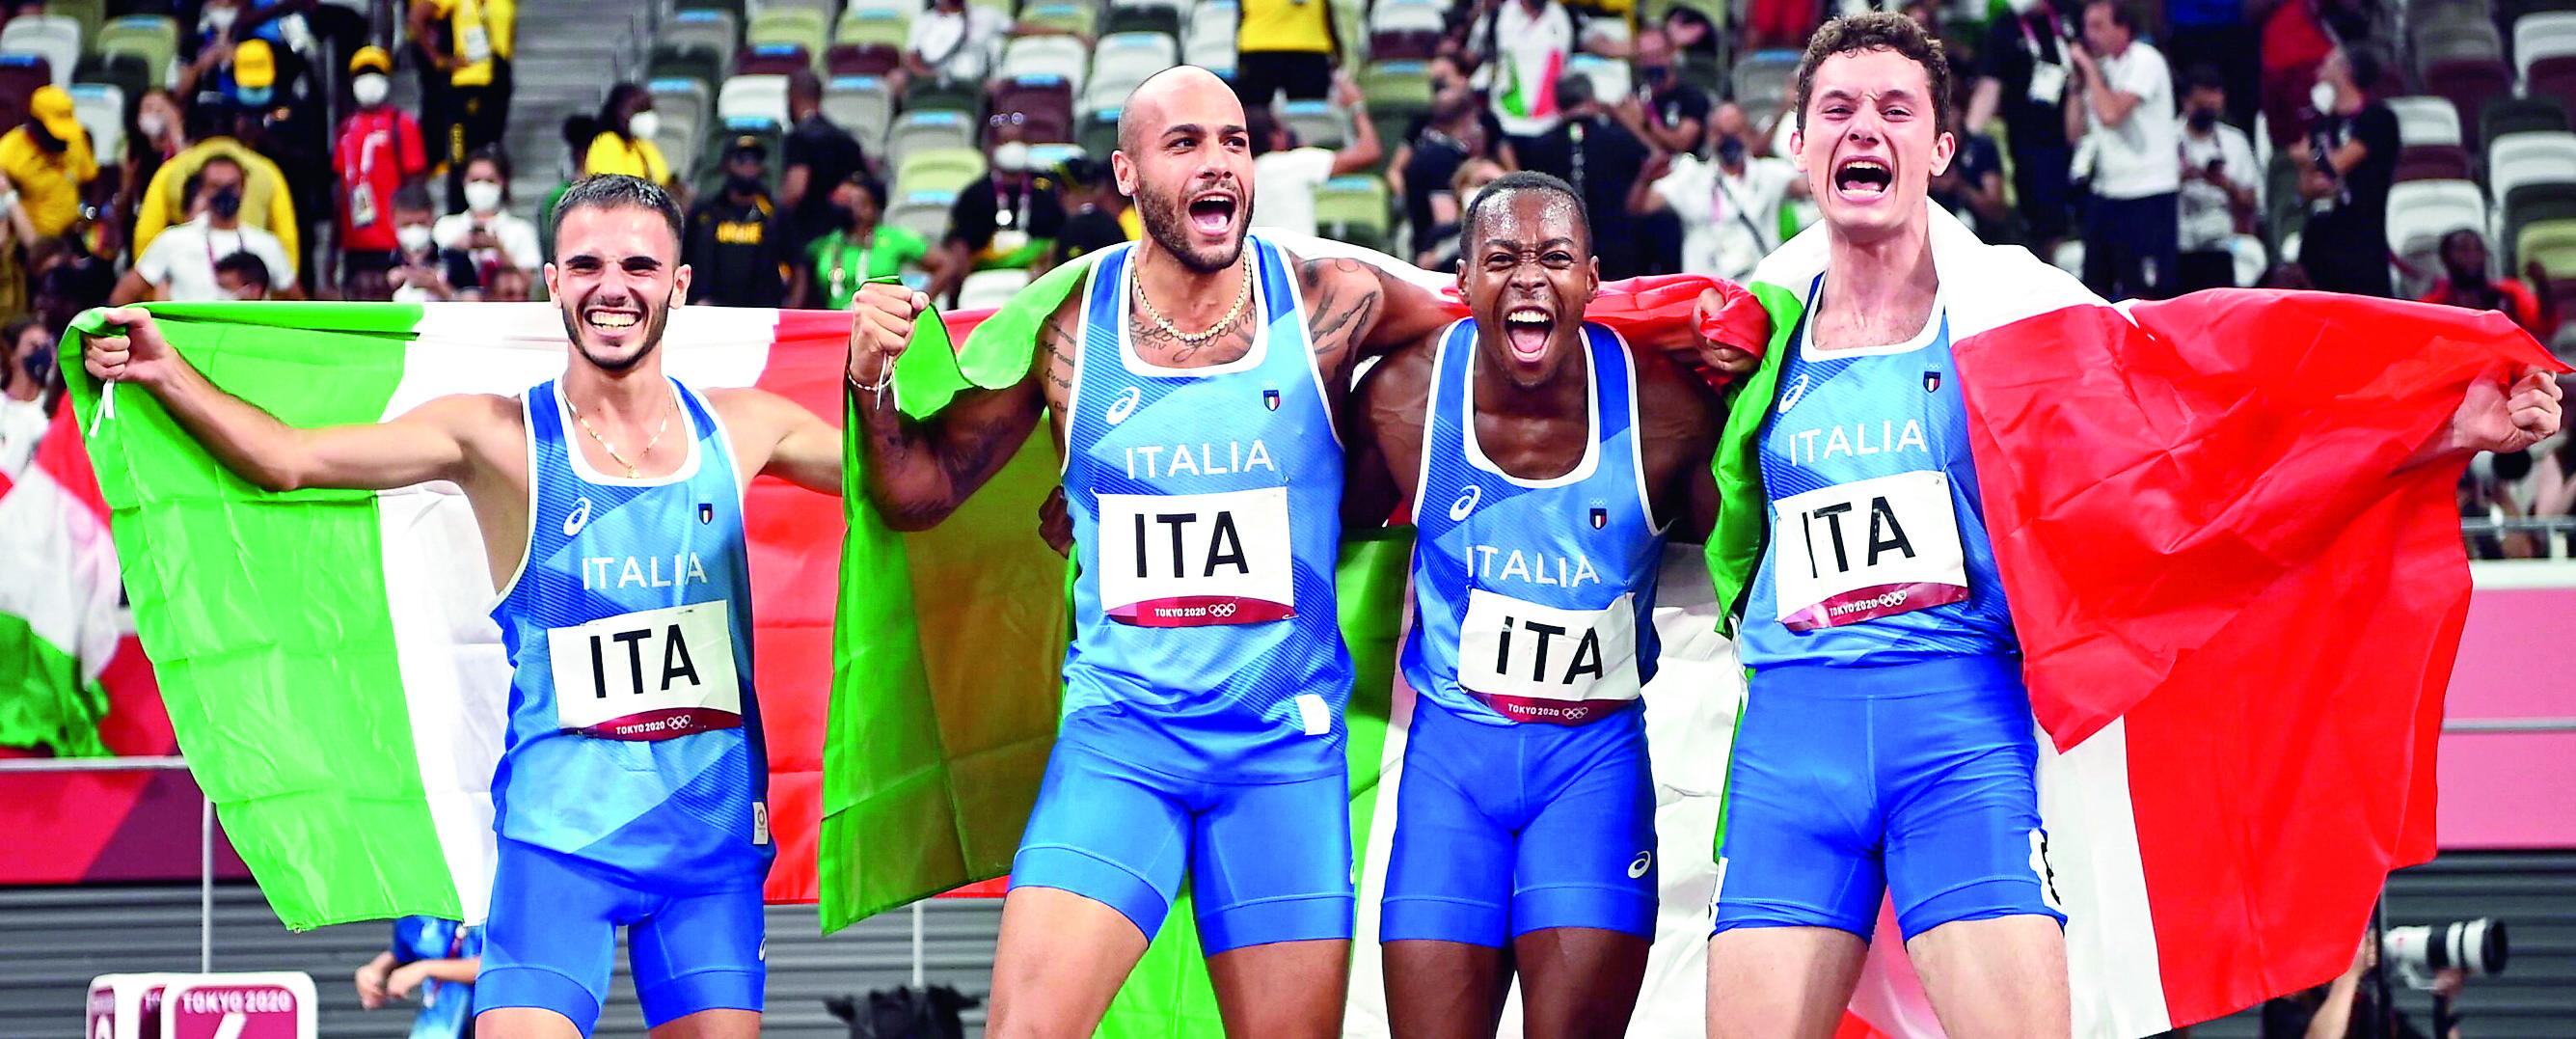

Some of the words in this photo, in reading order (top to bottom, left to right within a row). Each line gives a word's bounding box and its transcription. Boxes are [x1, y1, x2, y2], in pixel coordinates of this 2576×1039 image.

[1125, 439, 1275, 479] ITALIA
[1789, 419, 1928, 467] ITALIA
[1134, 510, 1250, 578] ITA
[1802, 496, 1916, 579] ITA
[582, 552, 708, 590] ITALIA
[1465, 544, 1601, 588] ITALIA
[1154, 608, 1183, 617] TOKYO
[1184, 607, 1207, 617] 2020
[1829, 605, 1854, 616] TOKYO
[1854, 598, 1878, 612] 2020
[589, 623, 701, 698] ITA
[1496, 615, 1604, 685] ITA
[615, 723, 645, 735] TOKYO
[644, 721, 665, 732] 2020
[1507, 703, 1536, 715] TOKYO
[1537, 707, 1559, 717] 2020
[179, 990, 245, 1014] TOKYO
[245, 989, 292, 1013] 2020
